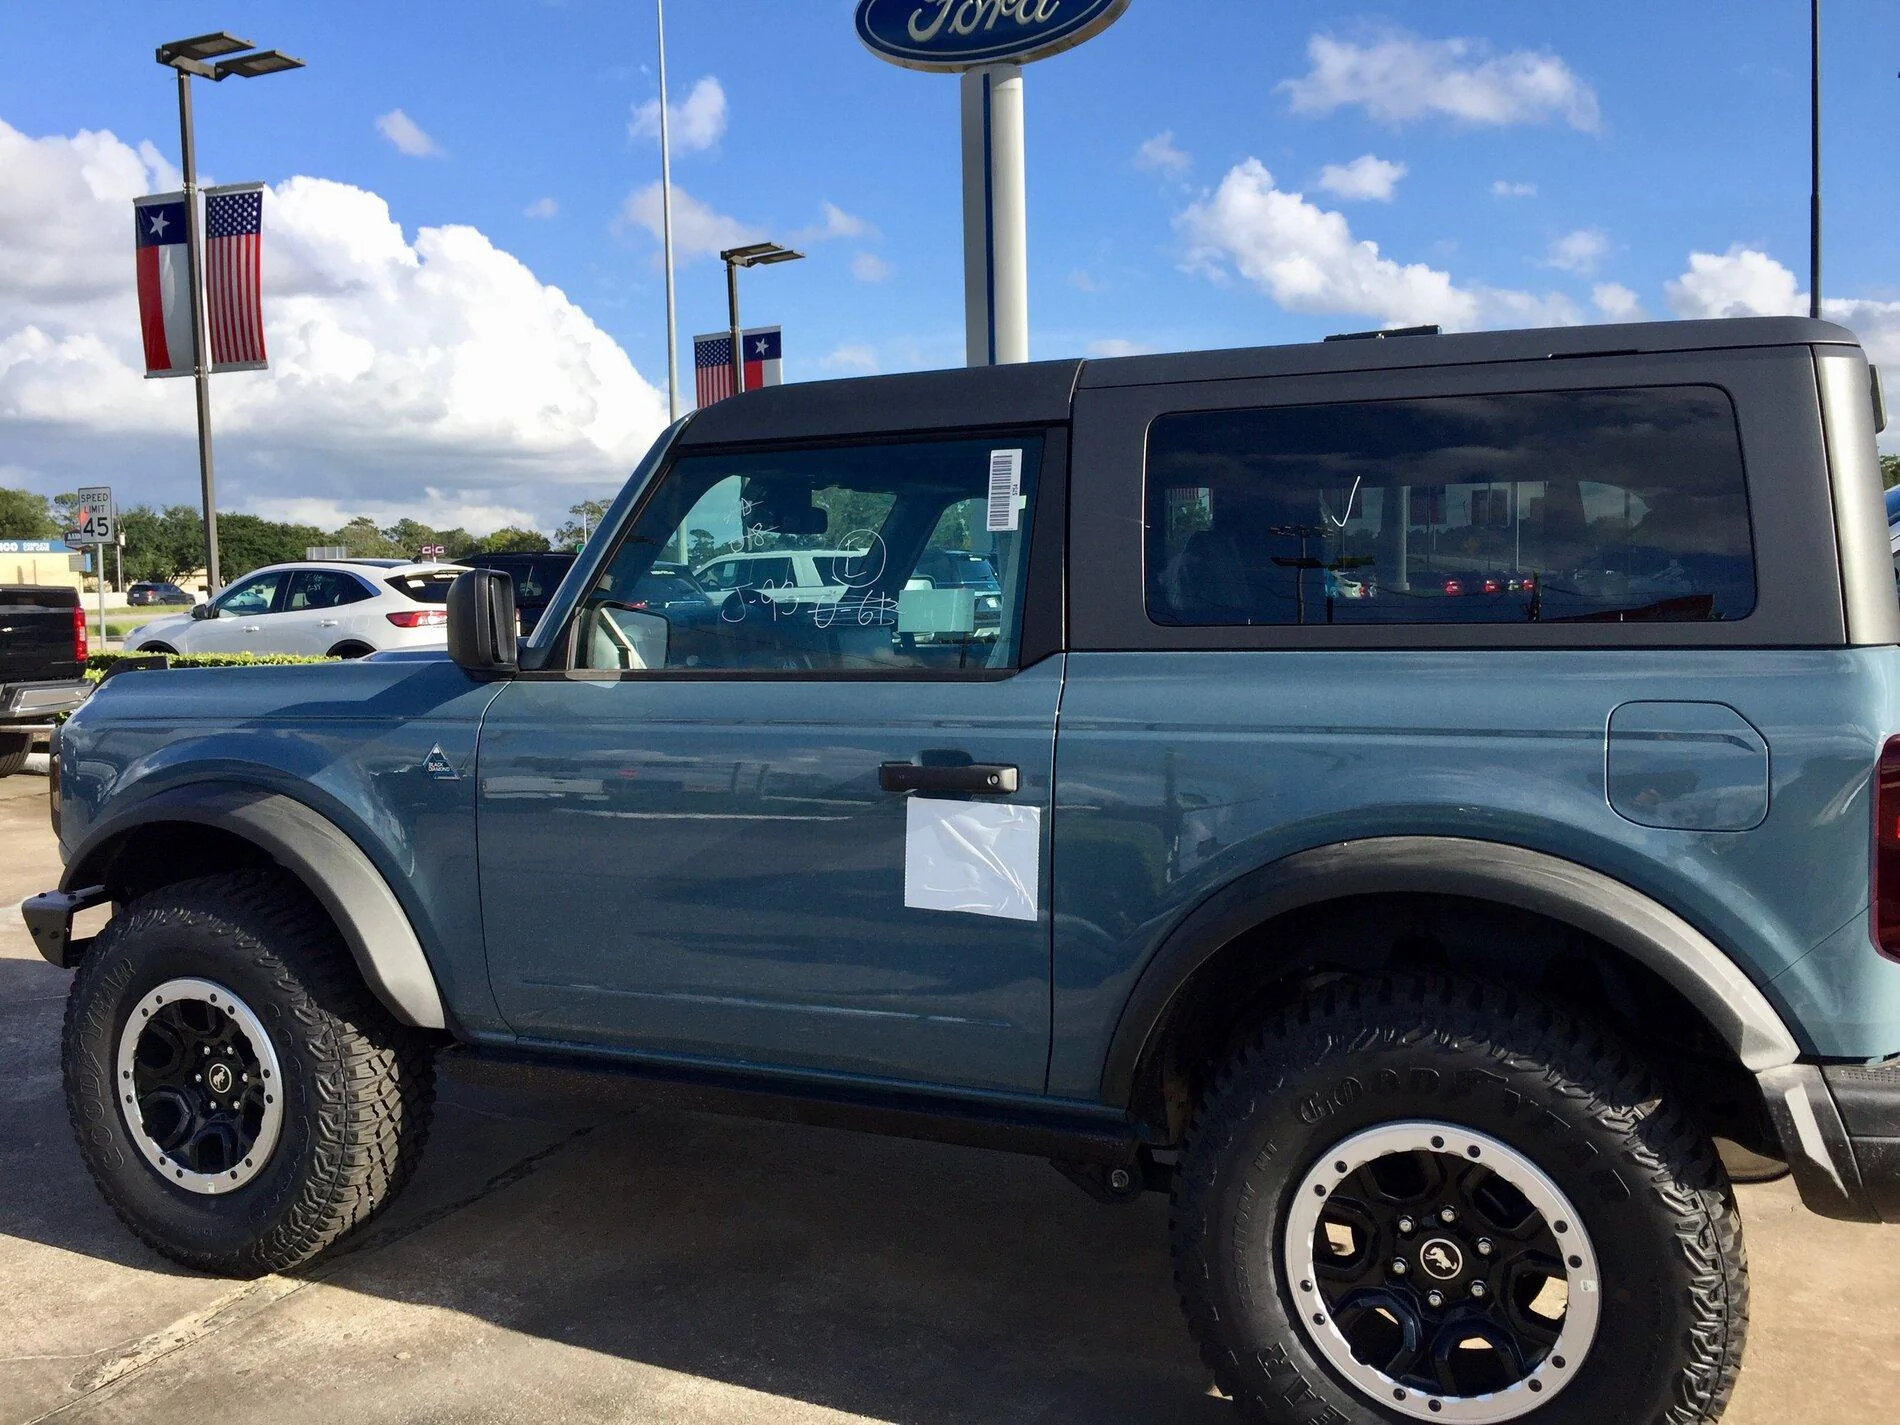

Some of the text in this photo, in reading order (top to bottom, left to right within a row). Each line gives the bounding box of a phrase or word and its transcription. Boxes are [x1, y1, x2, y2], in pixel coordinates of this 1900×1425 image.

[81, 493, 108, 502] SPEED
[84, 504, 105, 513] LIMIT
[83, 516, 109, 537] 45
